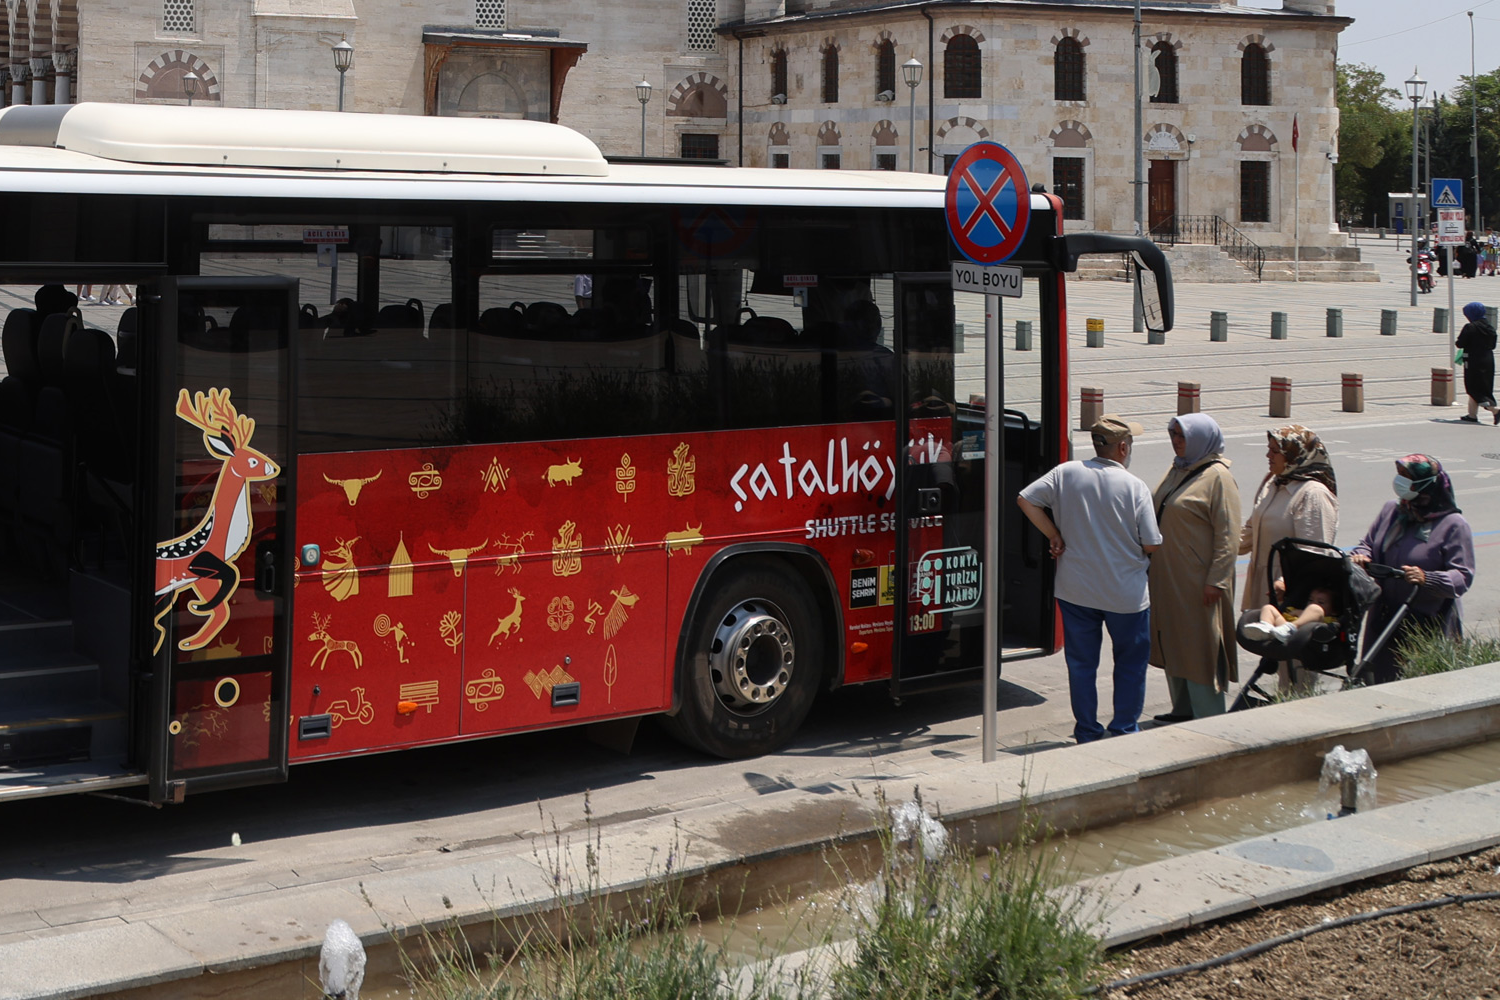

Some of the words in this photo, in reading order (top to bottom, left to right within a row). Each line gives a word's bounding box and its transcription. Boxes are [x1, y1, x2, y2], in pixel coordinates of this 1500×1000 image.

[955, 269, 979, 285] YOL
[982, 272, 1018, 289] BOYU
[804, 514, 877, 540] SHUTTLE
[946, 554, 978, 569] KONYA
[852, 577, 877, 588] BENİM
[946, 570, 978, 586] TURİZM
[945, 587, 977, 603] AJANSI
[909, 613, 935, 632] 13:00
